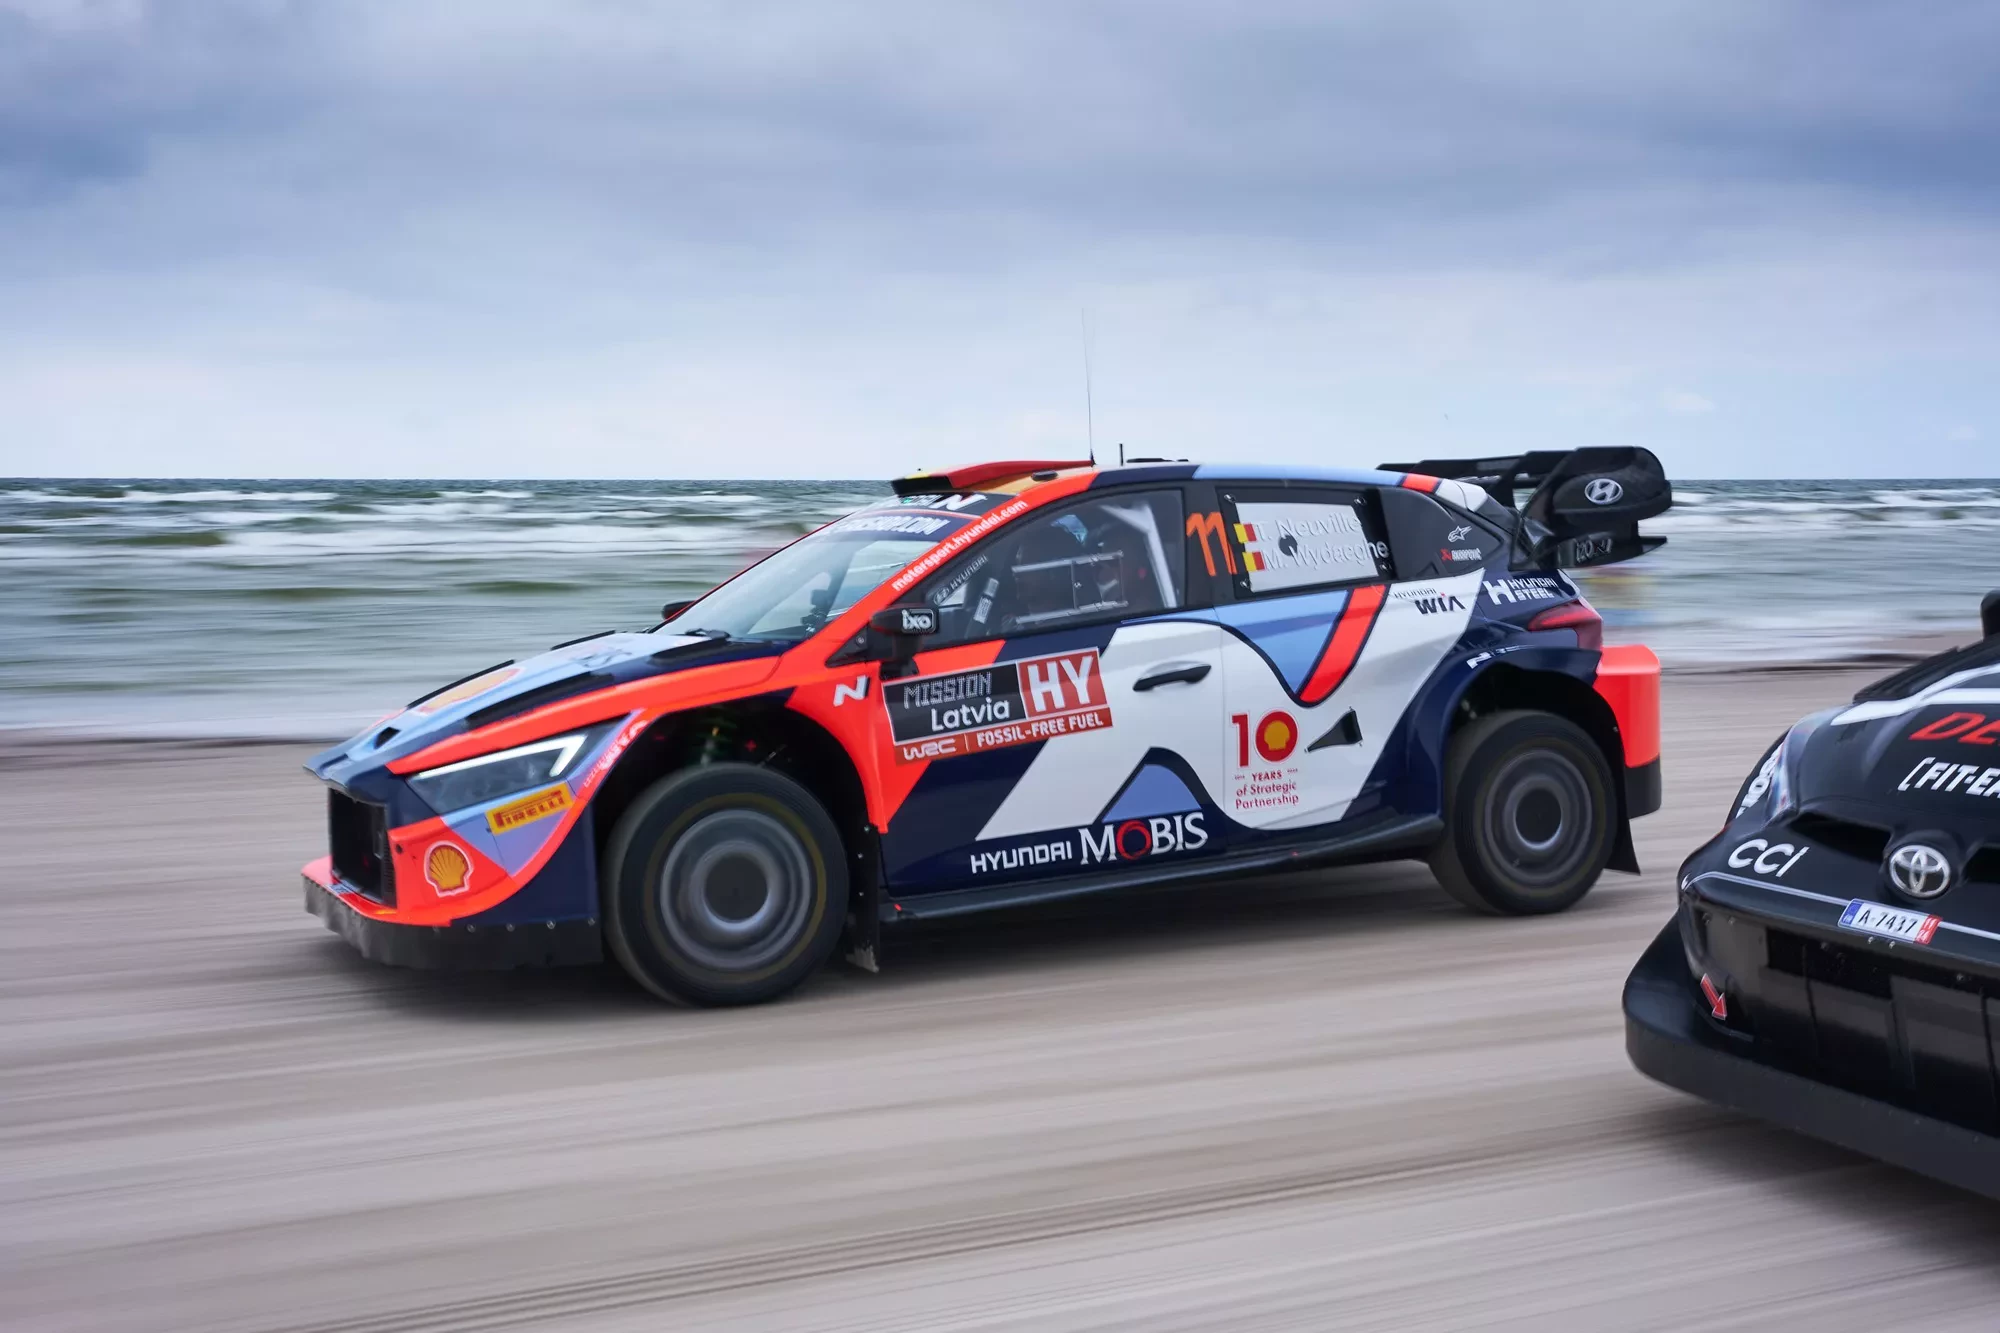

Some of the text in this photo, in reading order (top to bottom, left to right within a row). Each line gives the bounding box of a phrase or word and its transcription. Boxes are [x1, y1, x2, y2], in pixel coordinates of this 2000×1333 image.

[1275, 511, 1363, 539] Neuville
[891, 500, 1029, 591] motorsport.hyundai.com
[1288, 540, 1390, 570] Wydaeghe
[950, 554, 989, 590] HYUNDAI
[1509, 577, 1558, 590] HYUNDAI
[1393, 587, 1437, 599] HYUNDAI
[1514, 589, 1555, 601] STEEL
[903, 671, 993, 709] MISSION
[1027, 655, 1095, 713] HY
[931, 696, 1010, 732] Latvia
[903, 711, 1104, 761] WRC FOSSIL-FREE FUEL
[1236, 779, 1297, 797] of Strategic
[1252, 770, 1283, 782] YEARS
[493, 789, 566, 828] PIRELLI
[1235, 791, 1299, 810] Partnership
[970, 811, 1209, 874] HYUNDAI MOBIS
[1727, 838, 1810, 878] CCI
